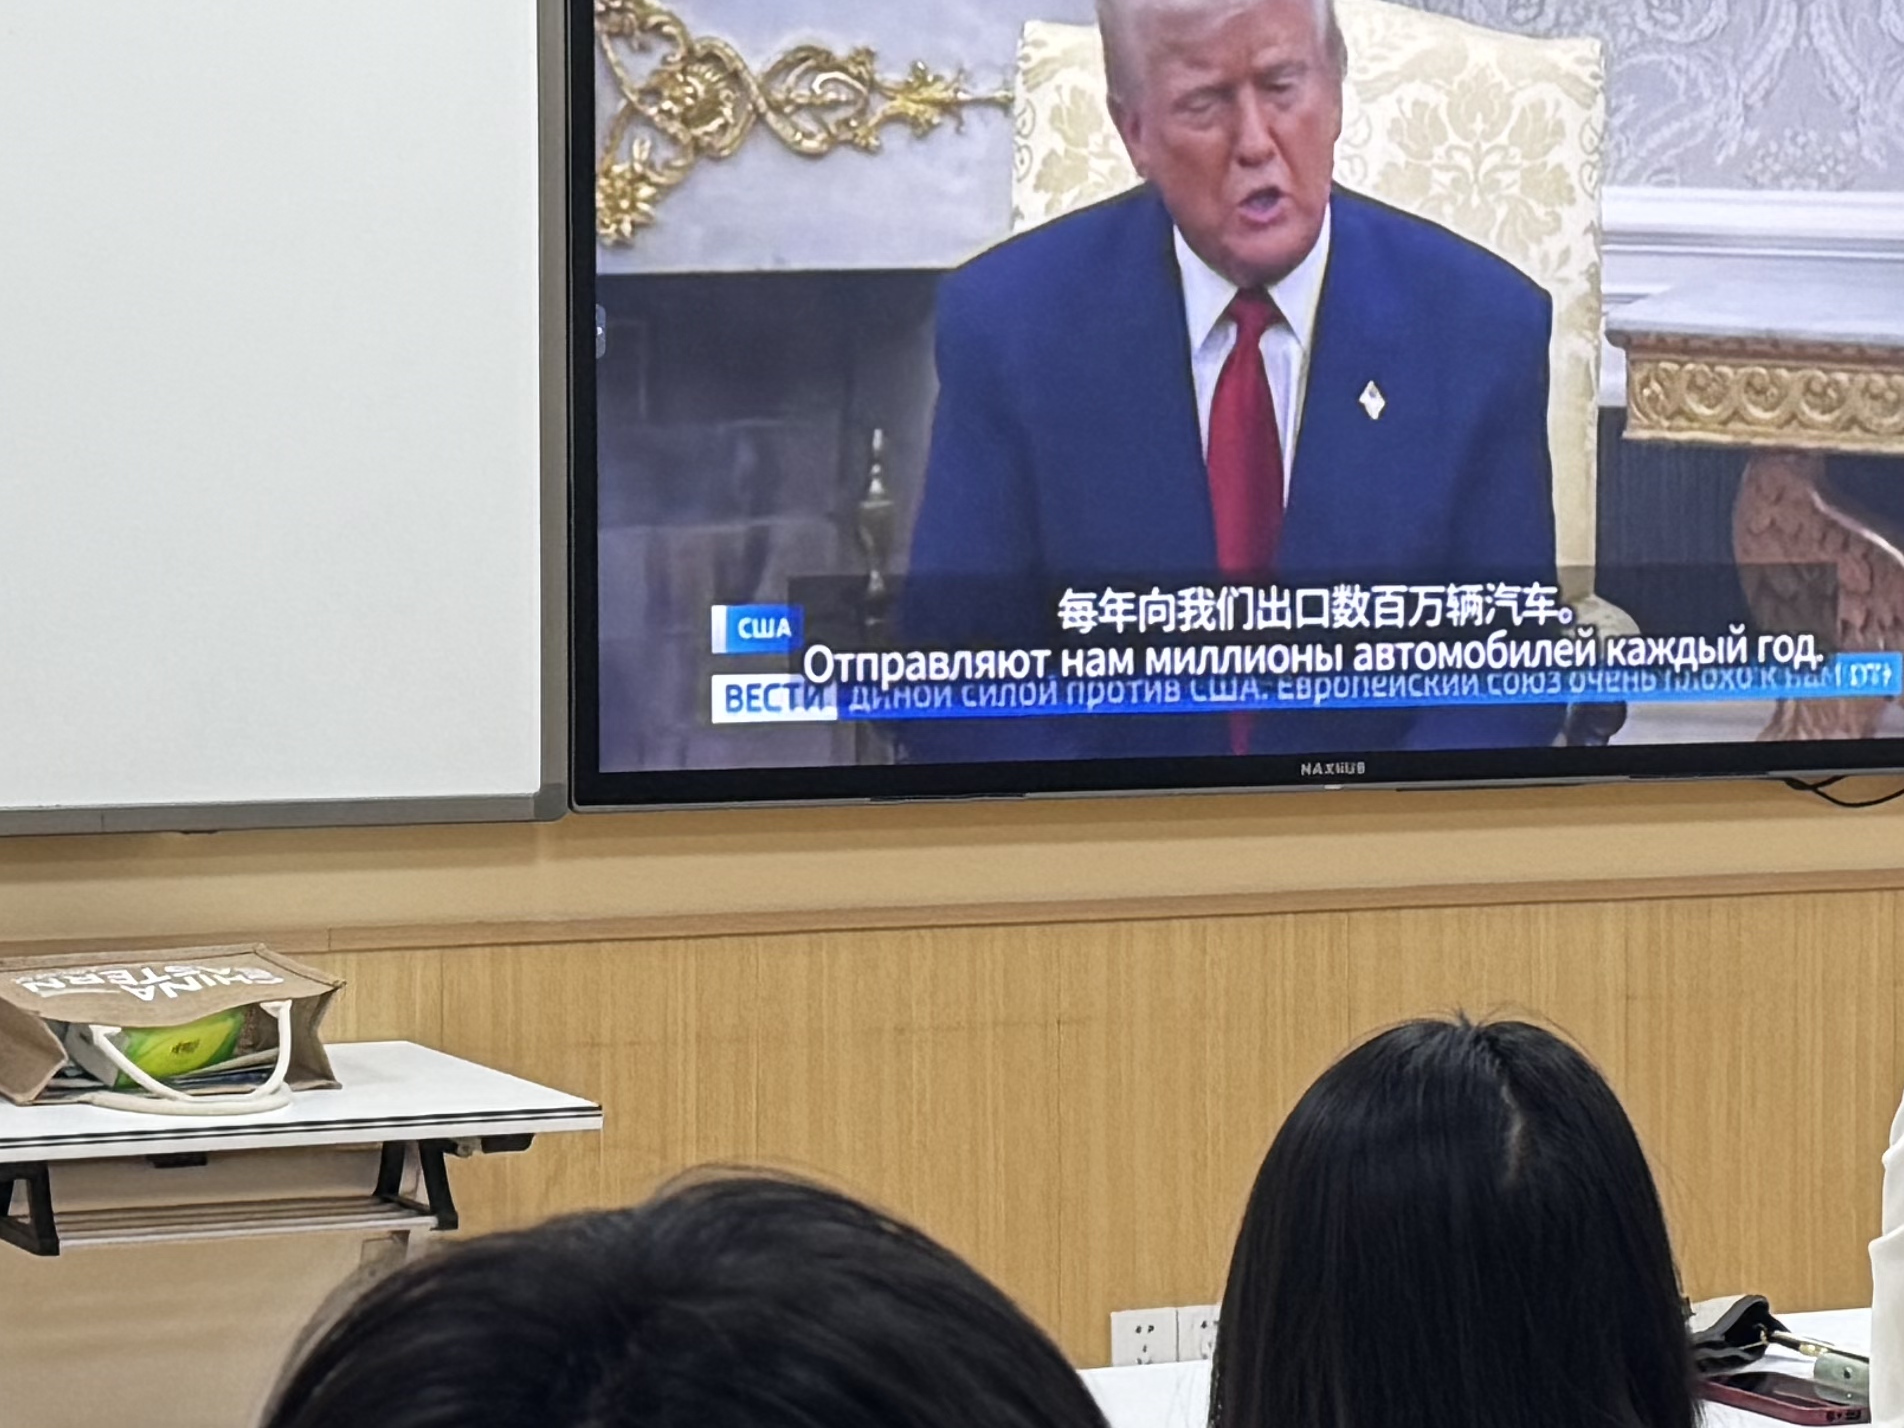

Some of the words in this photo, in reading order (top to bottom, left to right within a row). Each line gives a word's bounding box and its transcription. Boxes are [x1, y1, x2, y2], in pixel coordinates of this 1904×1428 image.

[737, 616, 793, 640] США
[1057, 581, 1573, 634] 每年向我们出口数百万辆汽车。
[803, 643, 1053, 690] Отправляют
[1061, 648, 1135, 678] нам
[1145, 643, 1343, 675] миллионы
[1353, 626, 1595, 673] автомобилей
[1606, 623, 1746, 672] каждый
[1757, 634, 1825, 670] год.
[725, 682, 826, 713] ВЕСТИ
[1067, 678, 1181, 711] против
[1488, 670, 1560, 697] союз
